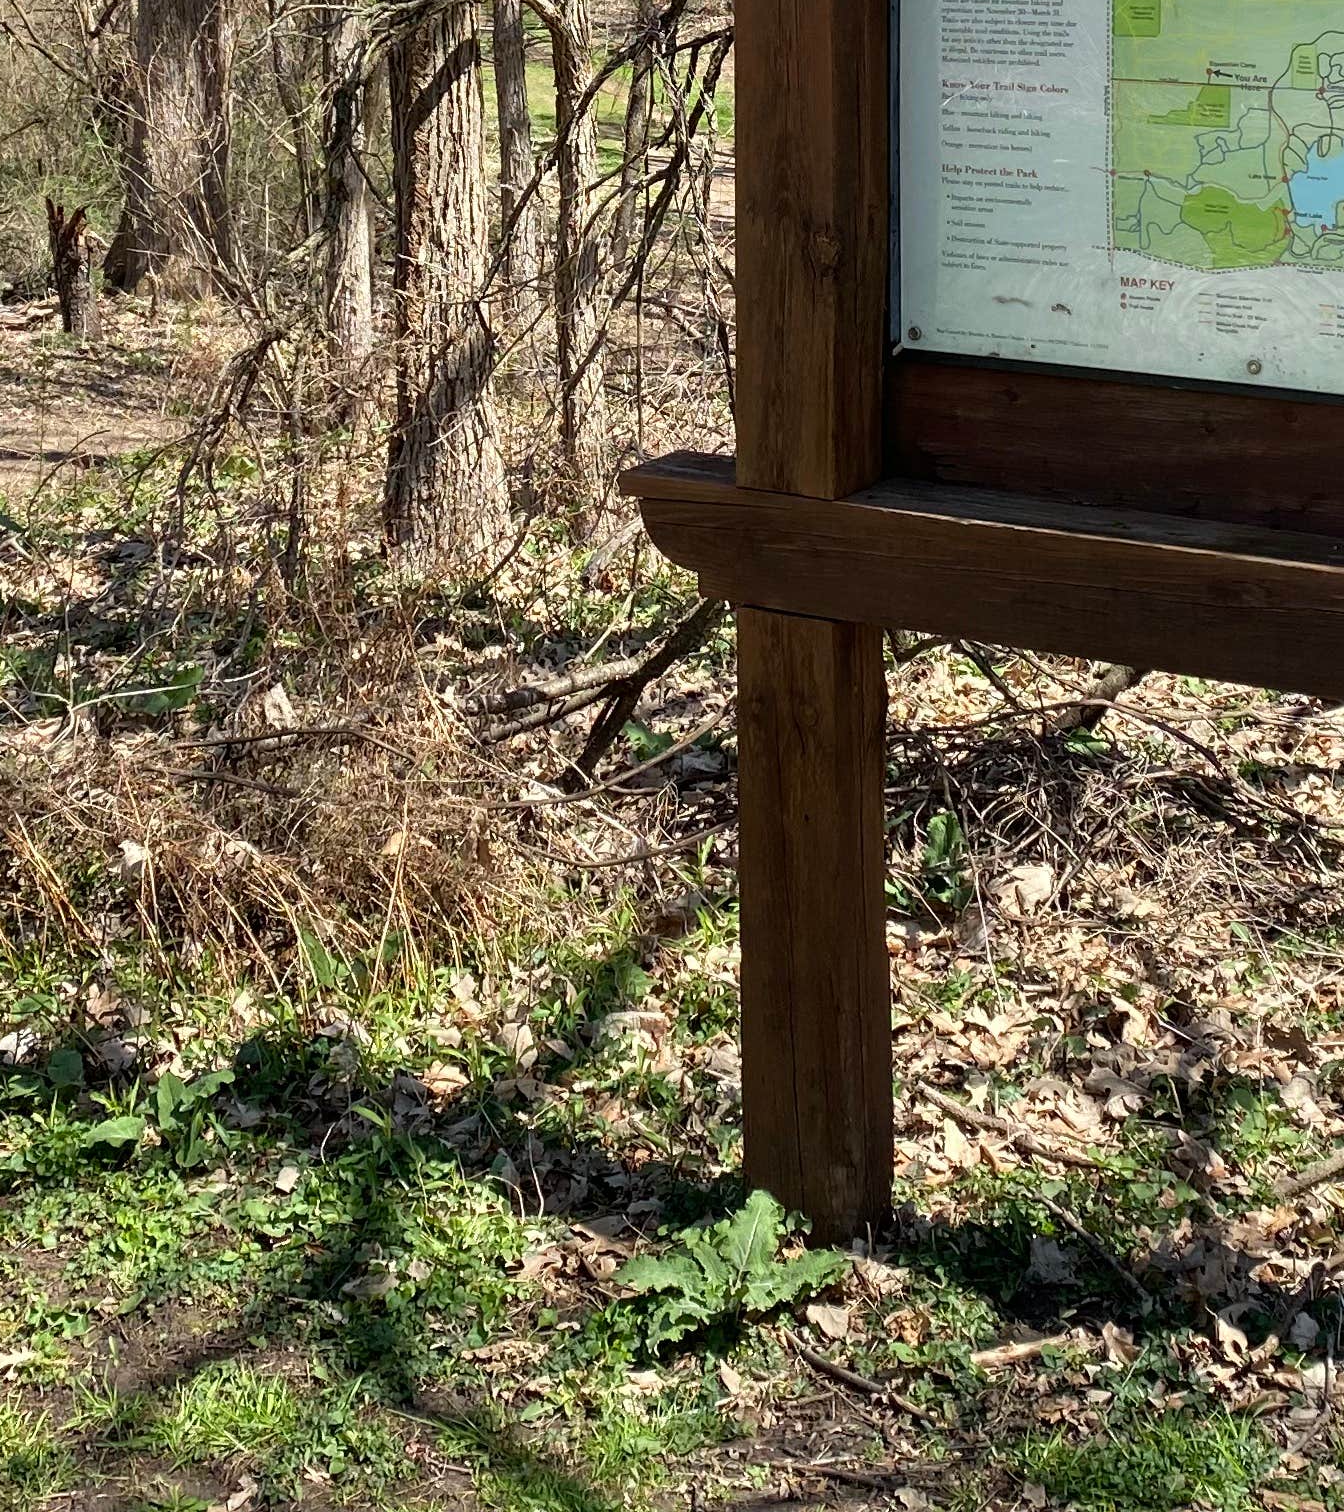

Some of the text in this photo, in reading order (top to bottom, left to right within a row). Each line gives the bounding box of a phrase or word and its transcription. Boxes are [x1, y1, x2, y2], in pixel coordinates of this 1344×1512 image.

[1235, 74, 1267, 83] You Are
[993, 82, 1014, 91] Trail
[1017, 82, 1036, 92] Sign
[942, 164, 1038, 178] Help Protect the Park
[1120, 277, 1175, 290] MAP KEY
